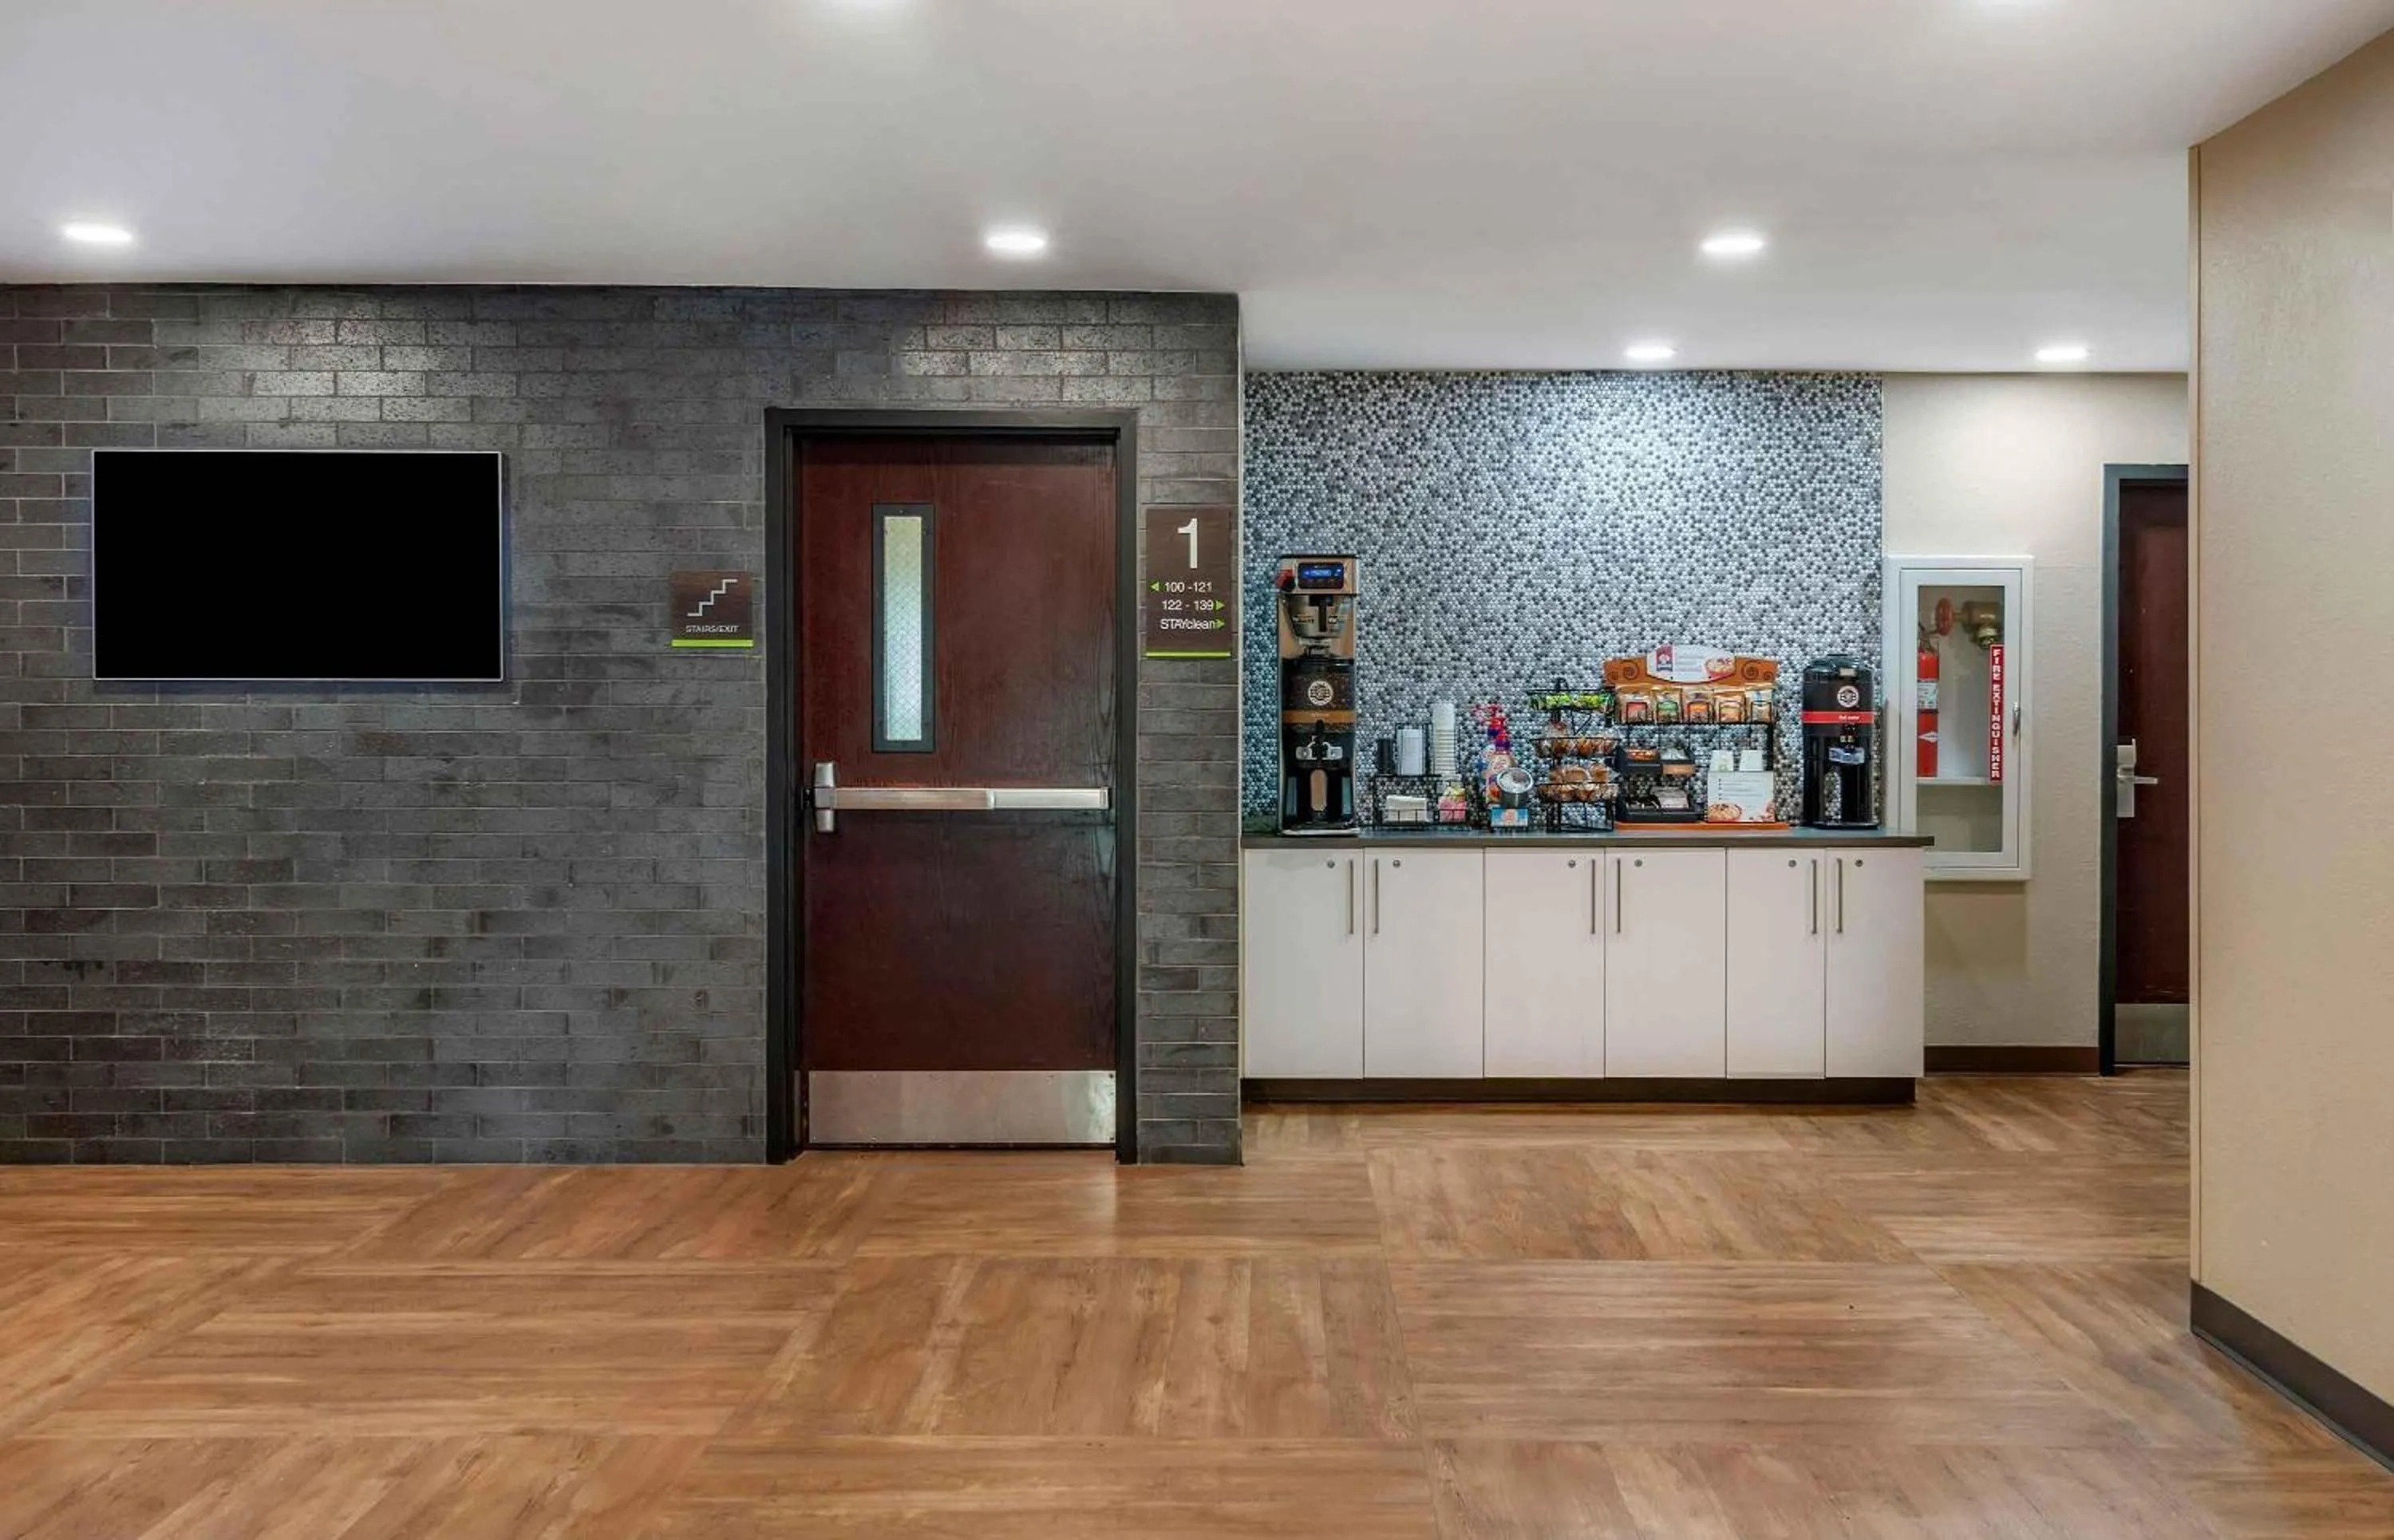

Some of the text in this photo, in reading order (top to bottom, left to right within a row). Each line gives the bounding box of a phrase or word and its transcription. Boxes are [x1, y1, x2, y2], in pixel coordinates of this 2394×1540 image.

[1177, 518, 1198, 569] 1
[1164, 582, 1185, 593] 100
[1161, 599, 1183, 611] 122
[1193, 599, 1215, 611] 139
[1159, 618, 1215, 630] STAYclean
[1991, 649, 2002, 778] FIRE EXTINGUISHER
